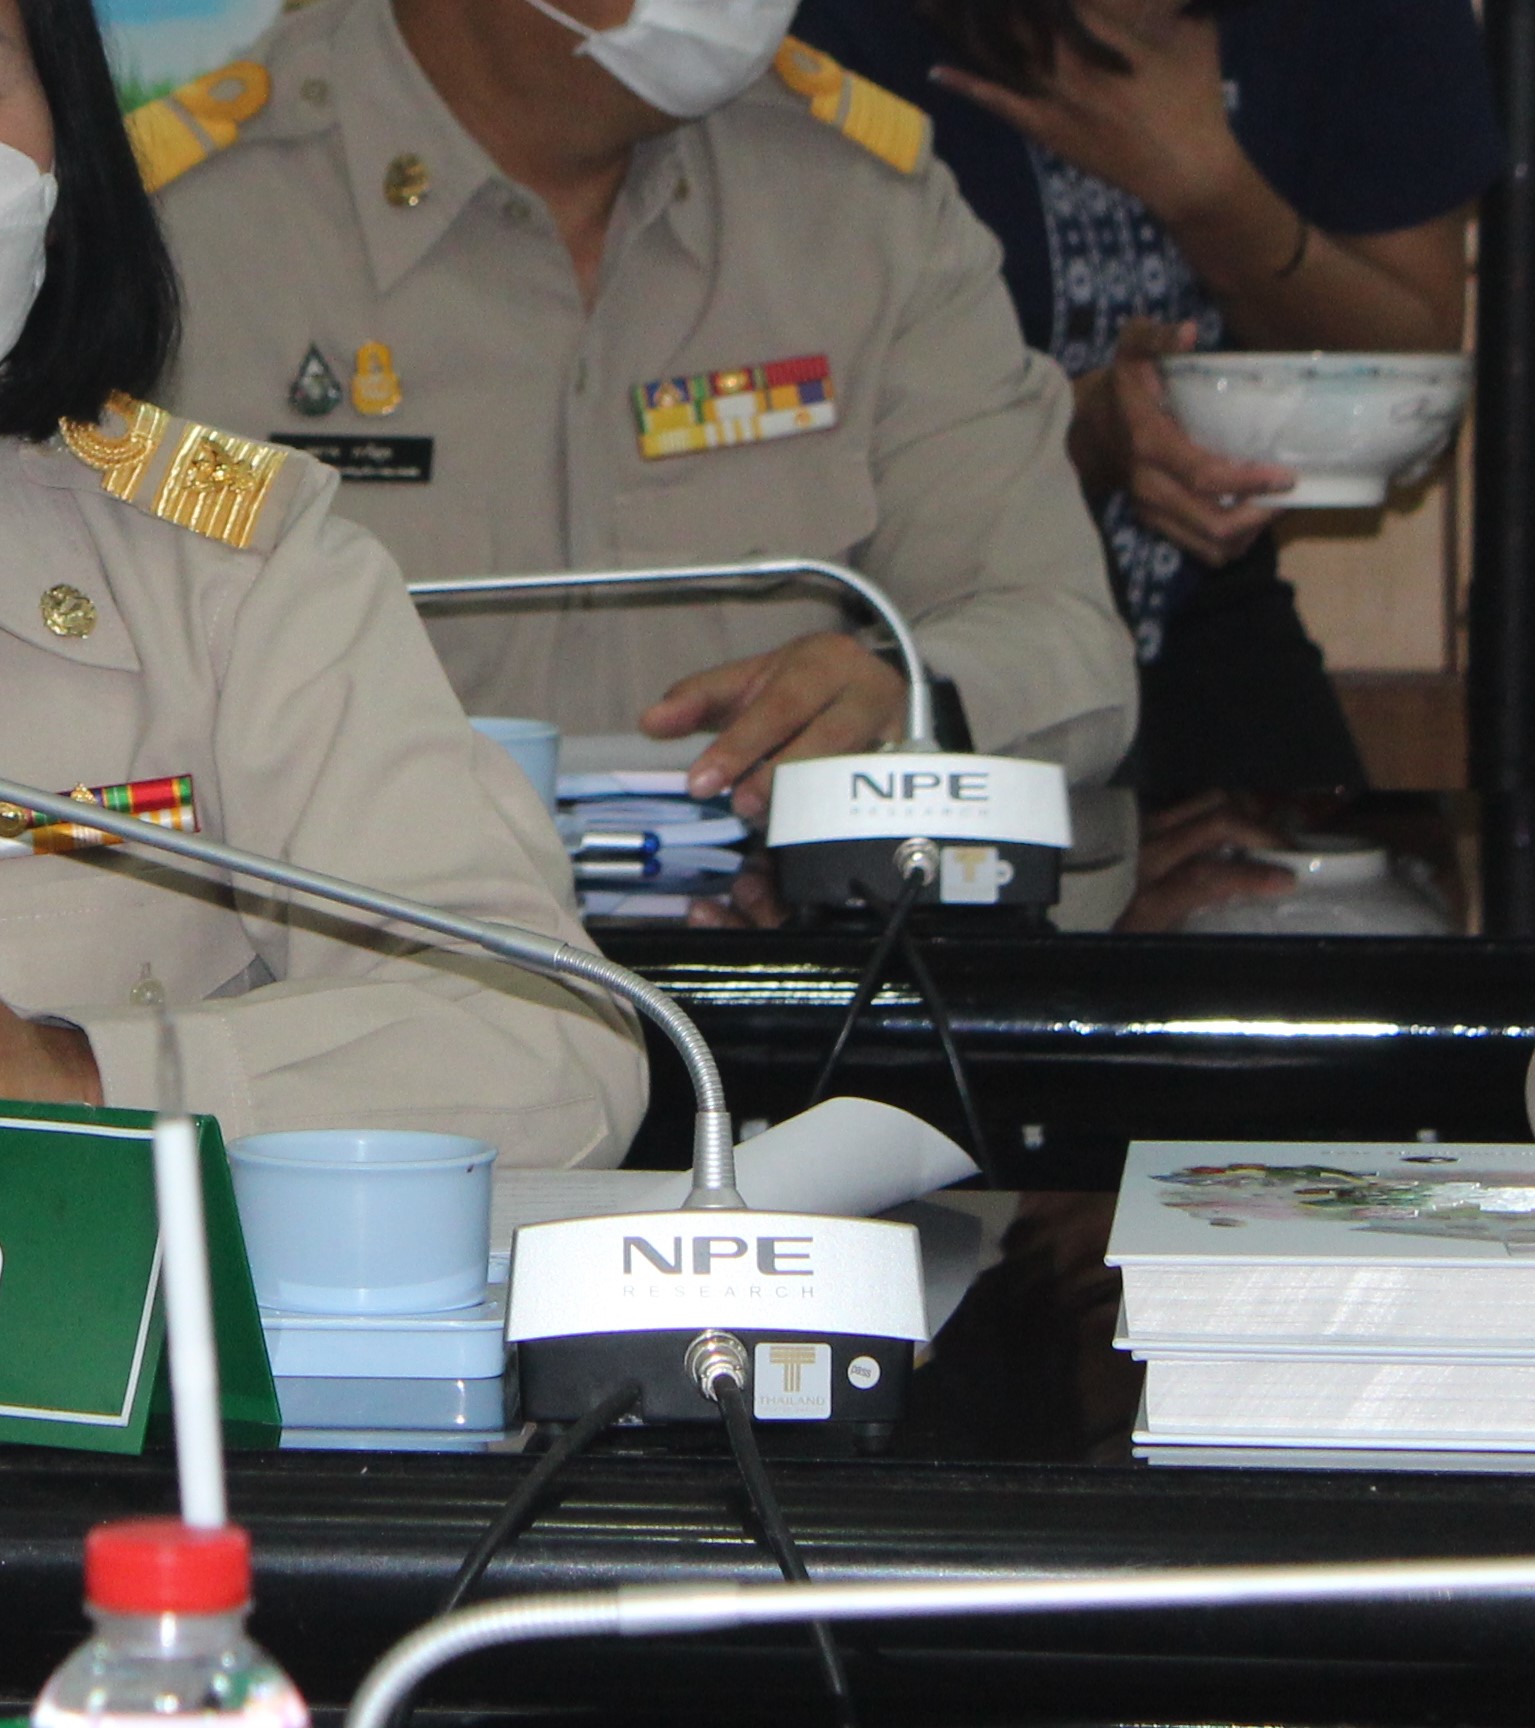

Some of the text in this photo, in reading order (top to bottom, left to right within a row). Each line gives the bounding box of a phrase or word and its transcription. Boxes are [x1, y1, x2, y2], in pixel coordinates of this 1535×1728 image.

[850, 772, 989, 801] NPE
[622, 1236, 814, 1276] NPE
[623, 1284, 815, 1299] RESEARCH
